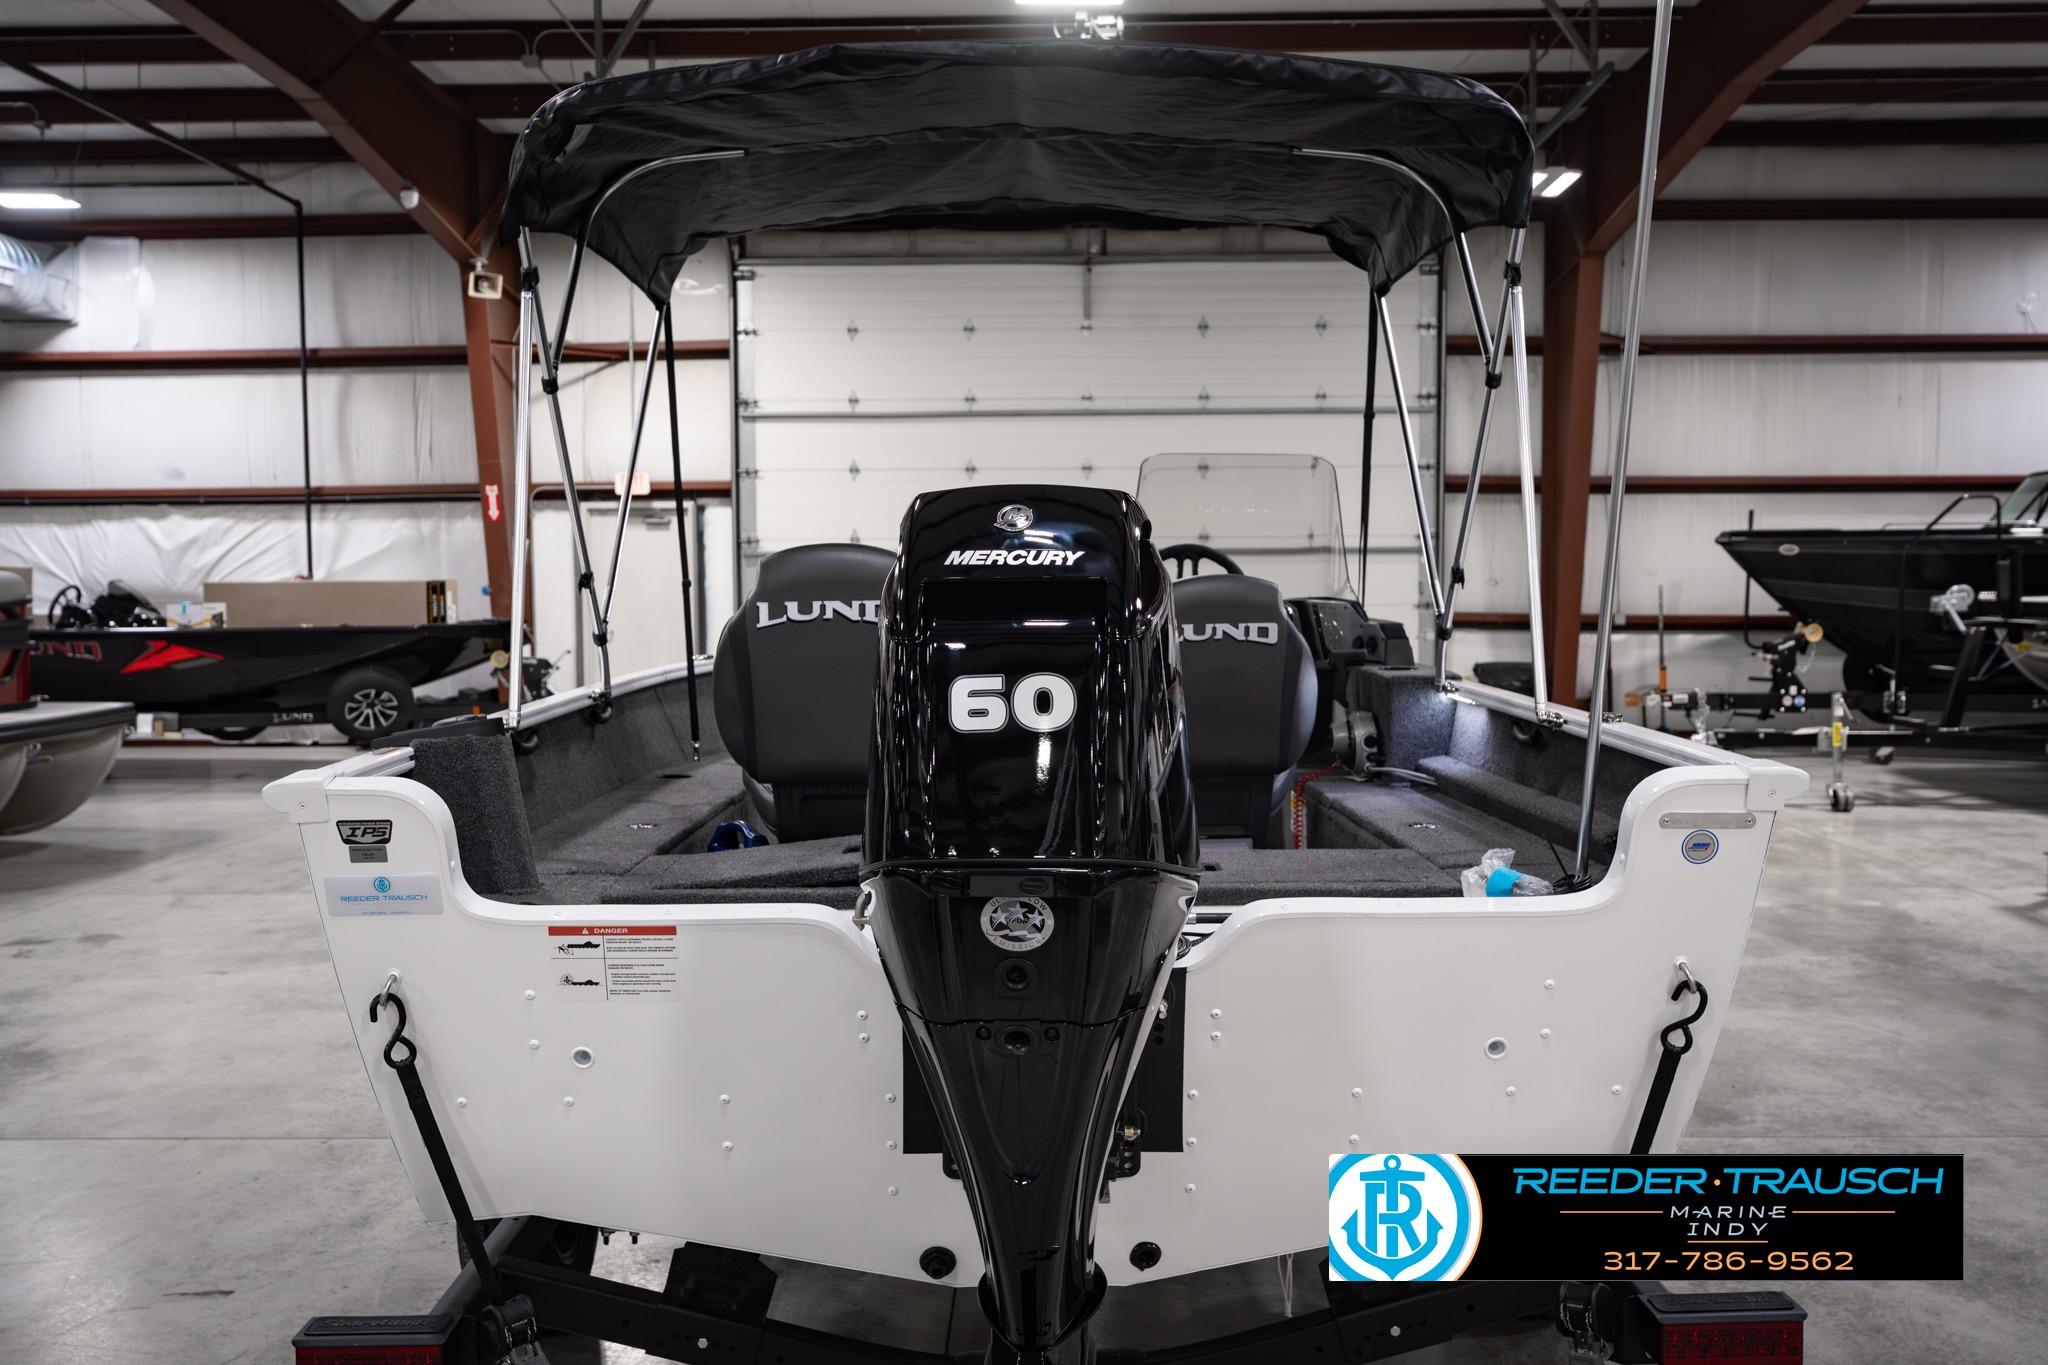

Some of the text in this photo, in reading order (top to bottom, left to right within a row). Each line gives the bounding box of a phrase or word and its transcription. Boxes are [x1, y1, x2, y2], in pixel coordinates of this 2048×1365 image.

[944, 550, 1086, 566] MERCURY
[1178, 622, 1278, 645] UND
[30, 640, 103, 661] UND
[948, 671, 1077, 734] 60
